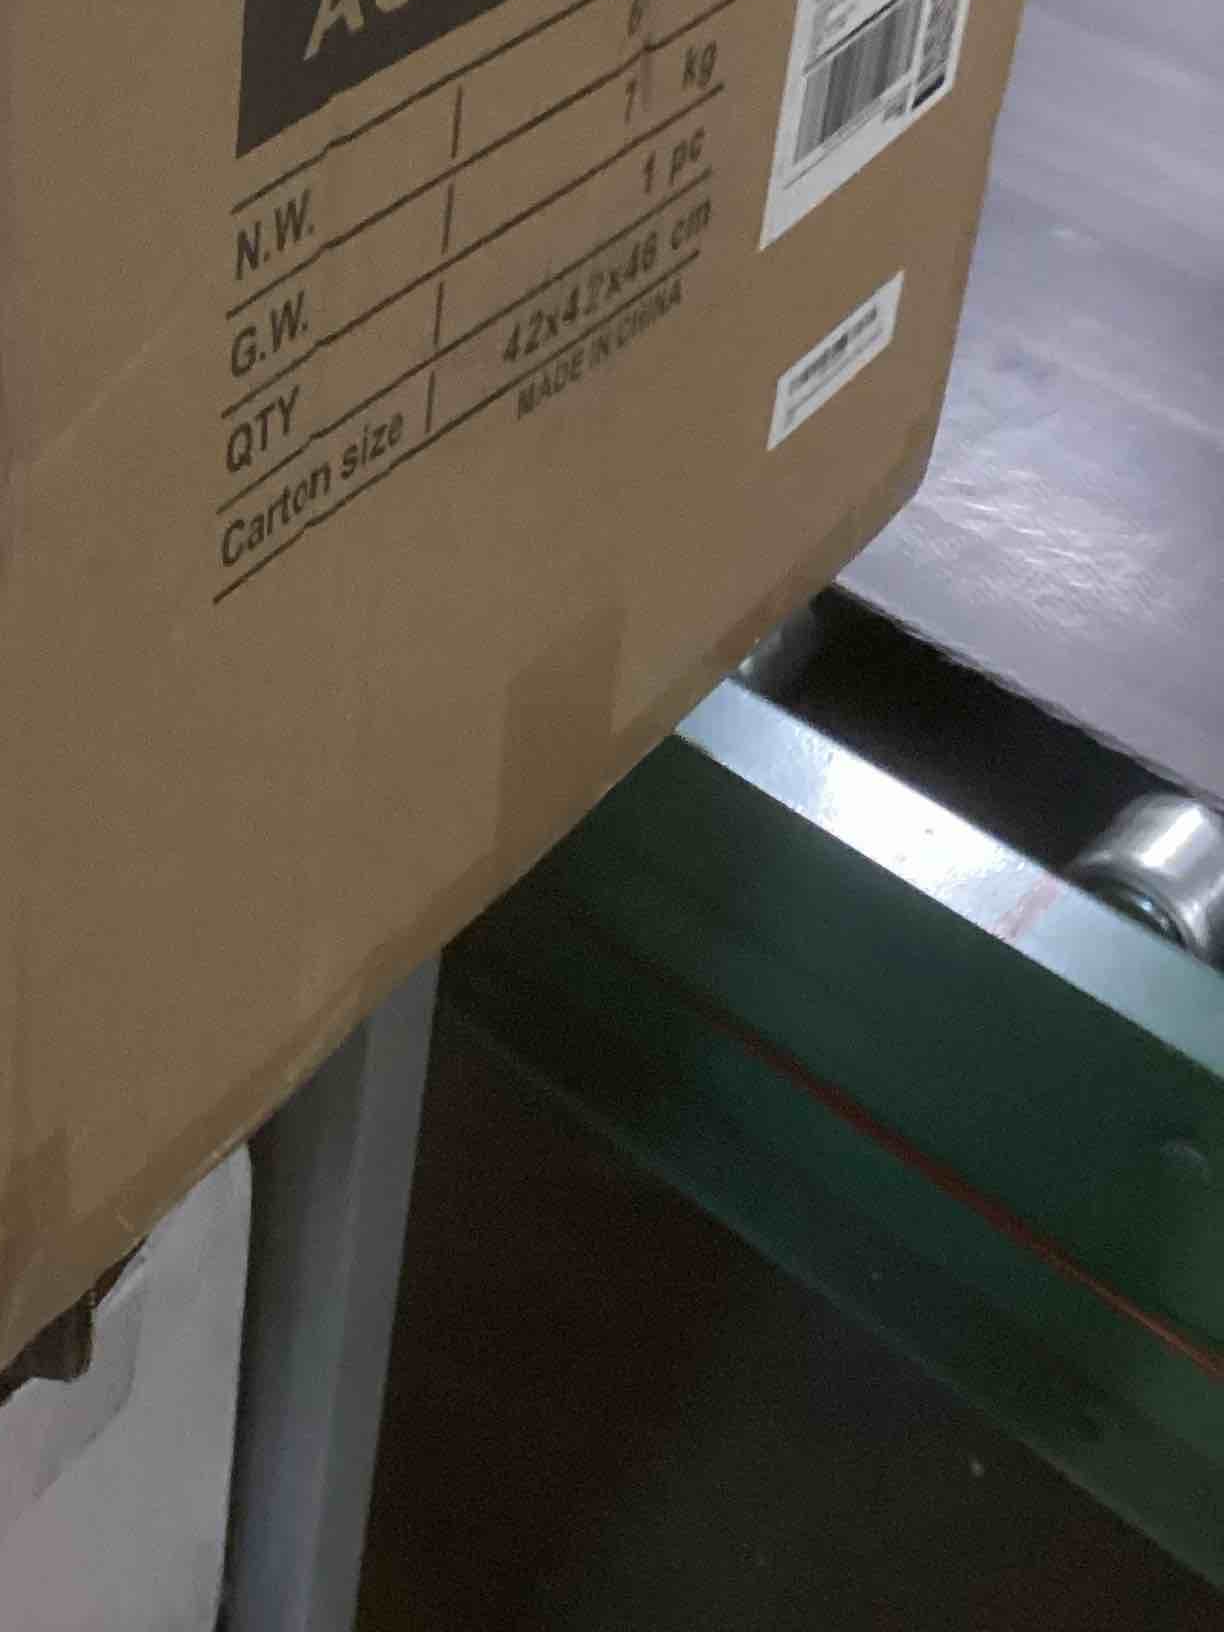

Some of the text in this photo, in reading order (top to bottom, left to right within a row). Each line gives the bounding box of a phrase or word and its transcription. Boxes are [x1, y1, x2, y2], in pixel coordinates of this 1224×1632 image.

[226, 125, 705, 473] QTY 1 pc
[231, 289, 309, 379] G.W.
[682, 39, 717, 91] kg
[235, 188, 315, 280] N.W.
[517, 277, 681, 421] MADE IN CHINA
[221, 457, 332, 568] Carton
[340, 411, 405, 480] size
[672, 197, 712, 252] cm
